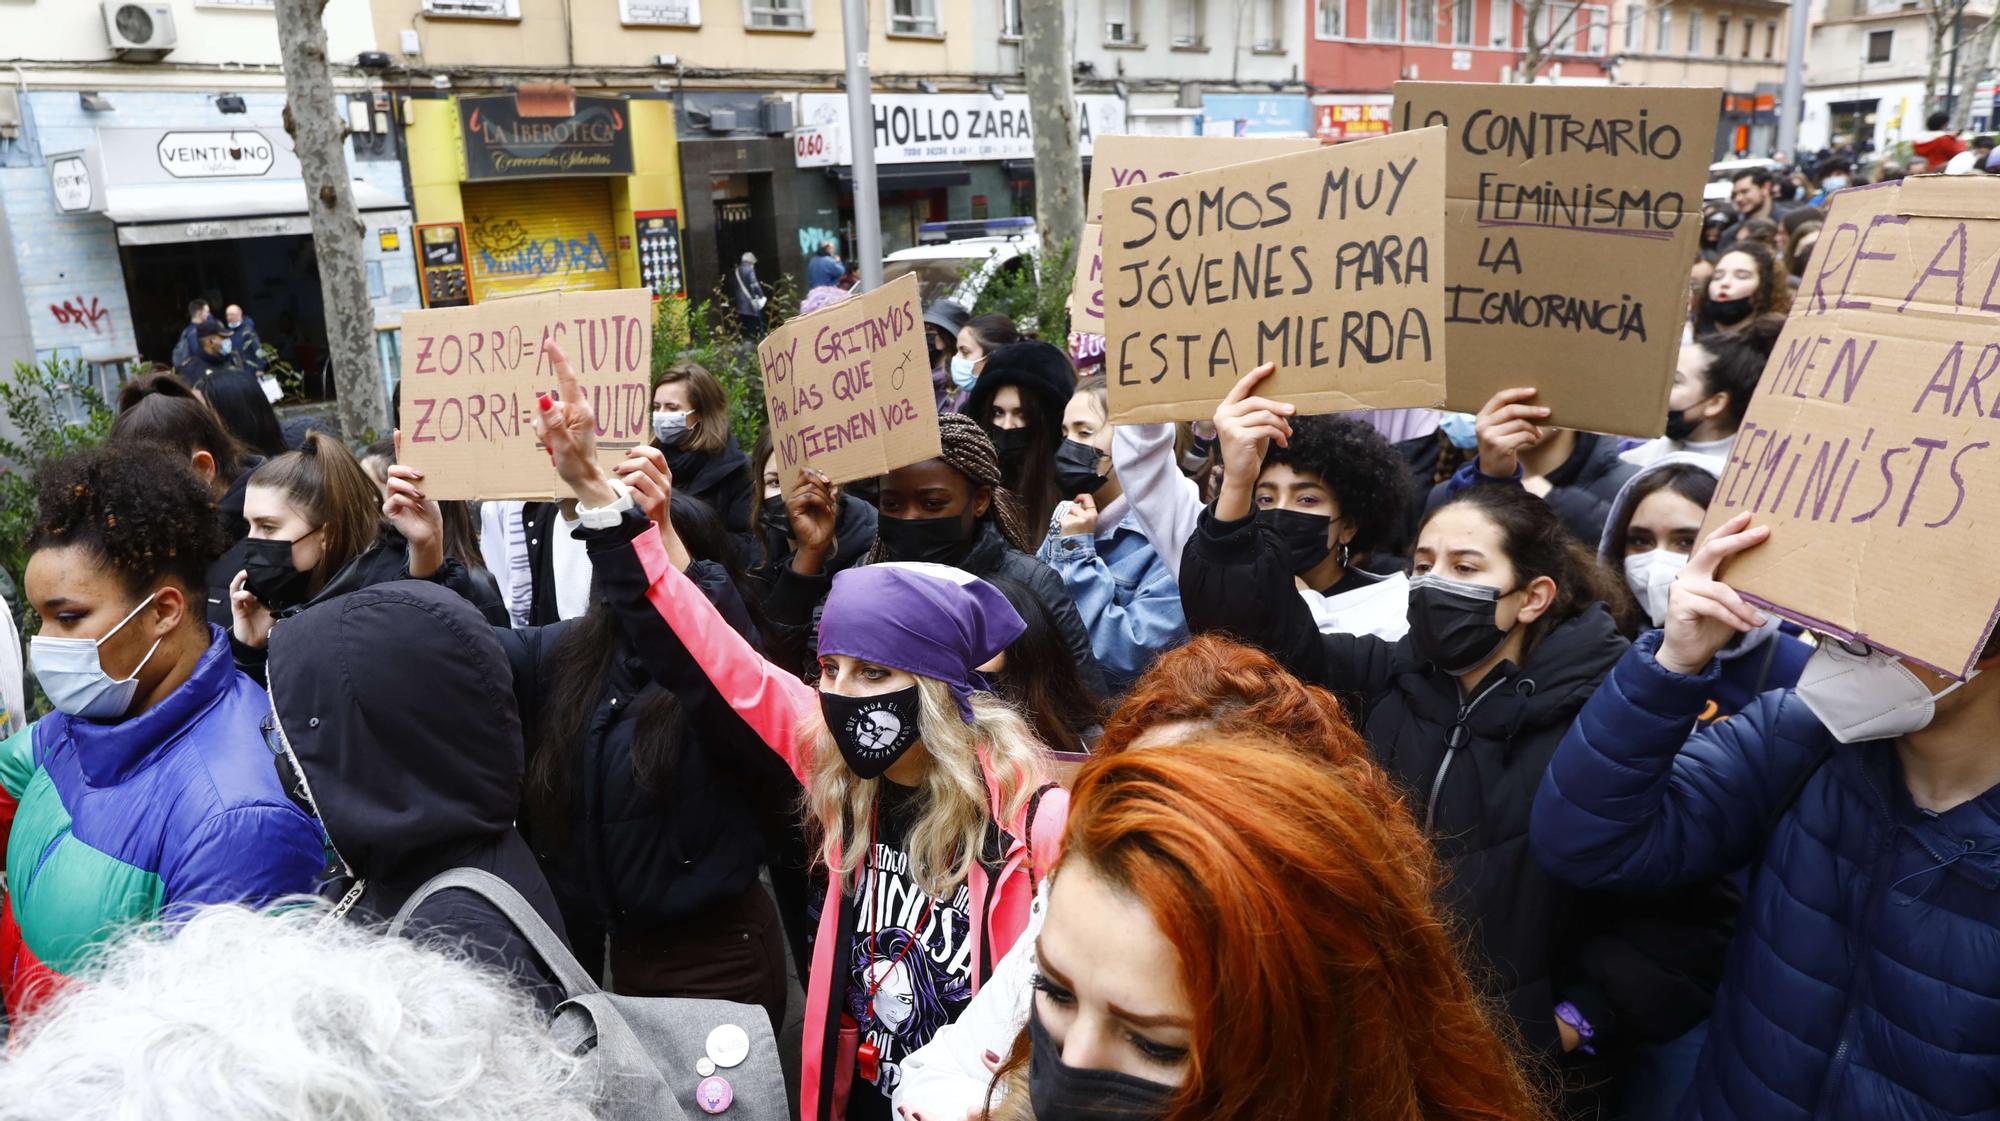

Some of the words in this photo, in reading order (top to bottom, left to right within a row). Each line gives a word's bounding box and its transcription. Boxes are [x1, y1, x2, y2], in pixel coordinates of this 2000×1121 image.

[873, 103, 959, 148] HOLLO
[967, 101, 1092, 145] ZARAA
[1462, 109, 1682, 160] CONTRARIO
[1123, 181, 1292, 249] SOMOS
[1318, 157, 1418, 220] MUY
[1477, 172, 1685, 230] FEMINISMO
[1119, 243, 1313, 310] JÓVENES
[1335, 234, 1429, 291] PARA
[1477, 237, 1523, 275] LA
[1445, 284, 1648, 343] IGNORANCIA
[762, 337, 798, 388] HOY
[814, 300, 914, 365] GRITAMOS
[1119, 327, 1238, 386] ESTA
[1257, 307, 1433, 369] MIERDA
[771, 396, 789, 429] POR
[793, 383, 824, 416] LAS
[832, 359, 874, 401] QUE
[1768, 335, 1878, 405] MEN
[1911, 339, 2000, 419] AR
[880, 397, 919, 431] VOZ
[1714, 421, 1991, 528] FEMINISTS
[845, 716, 858, 732] QUE
[857, 702, 883, 715] ARDA
[887, 702, 898, 712] EL
[856, 725, 911, 759] PATRIARCADO
